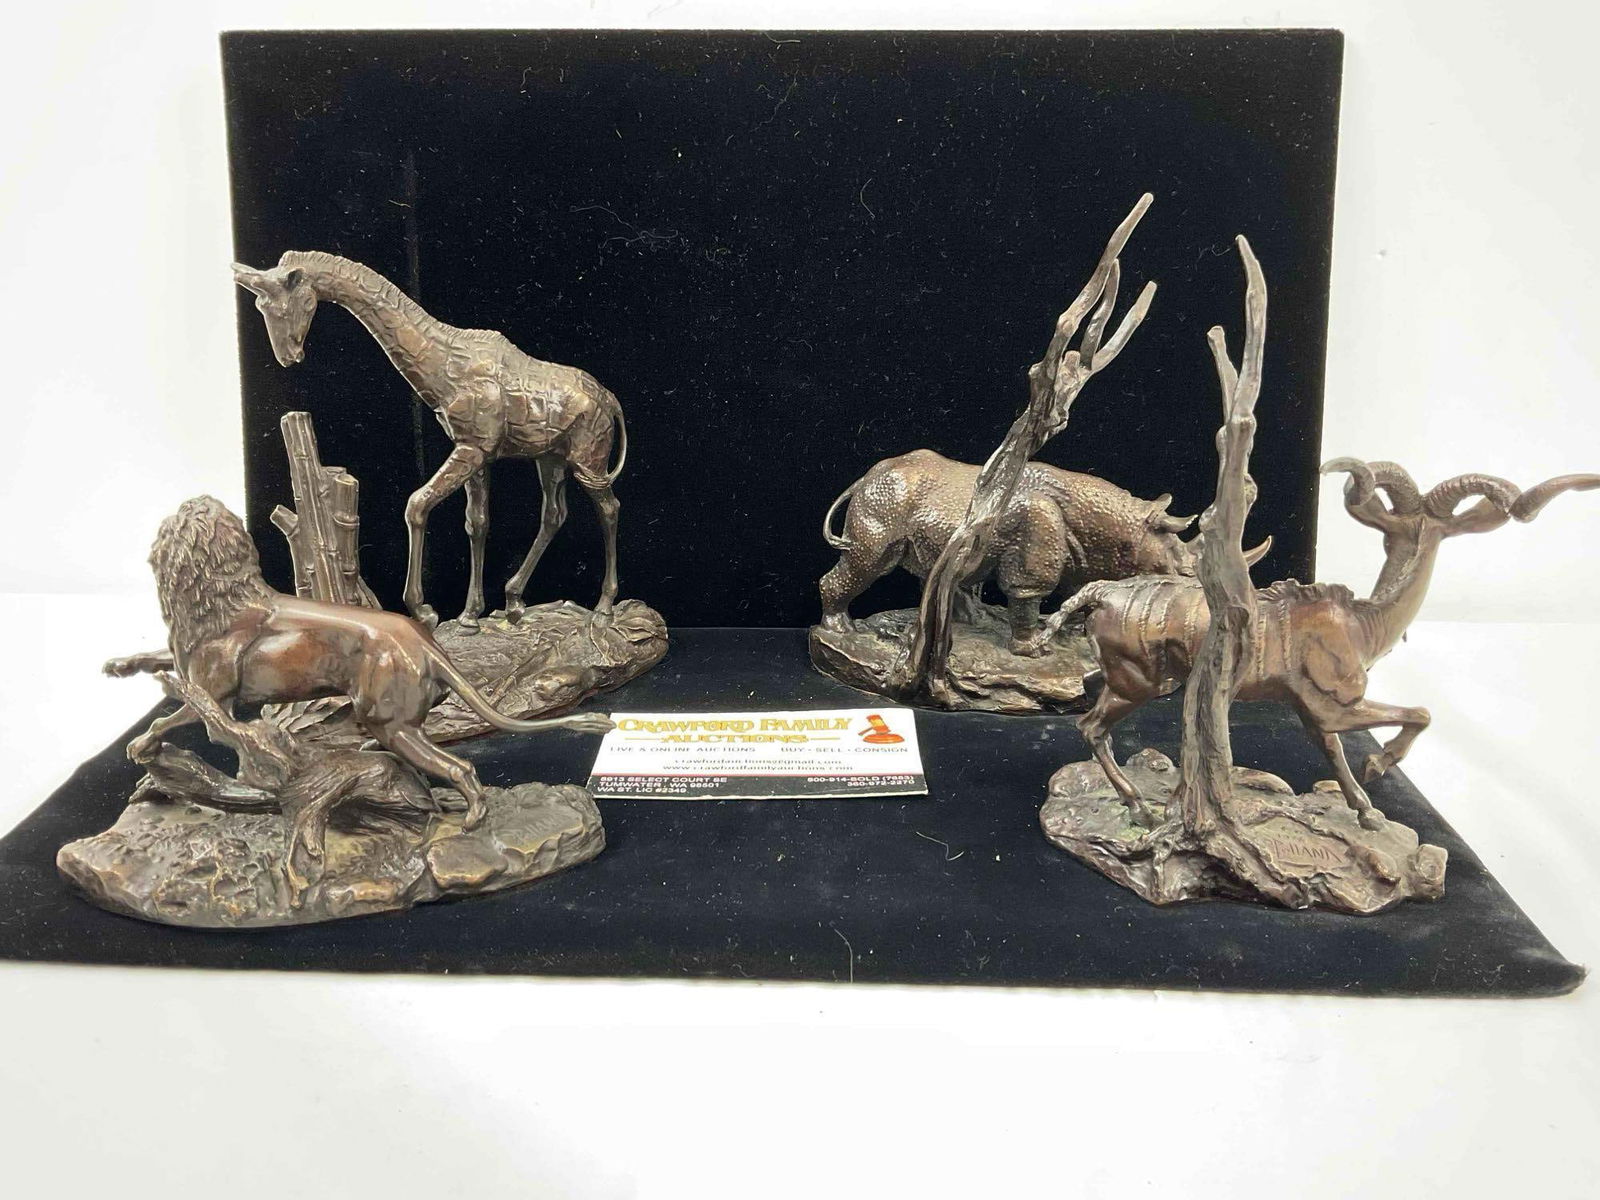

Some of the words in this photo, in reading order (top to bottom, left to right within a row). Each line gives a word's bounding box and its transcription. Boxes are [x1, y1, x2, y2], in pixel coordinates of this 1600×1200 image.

[617, 718, 755, 733] CRAWFORD
[760, 717, 853, 731] FAMILY
[661, 734, 809, 743] AUCTIONS
